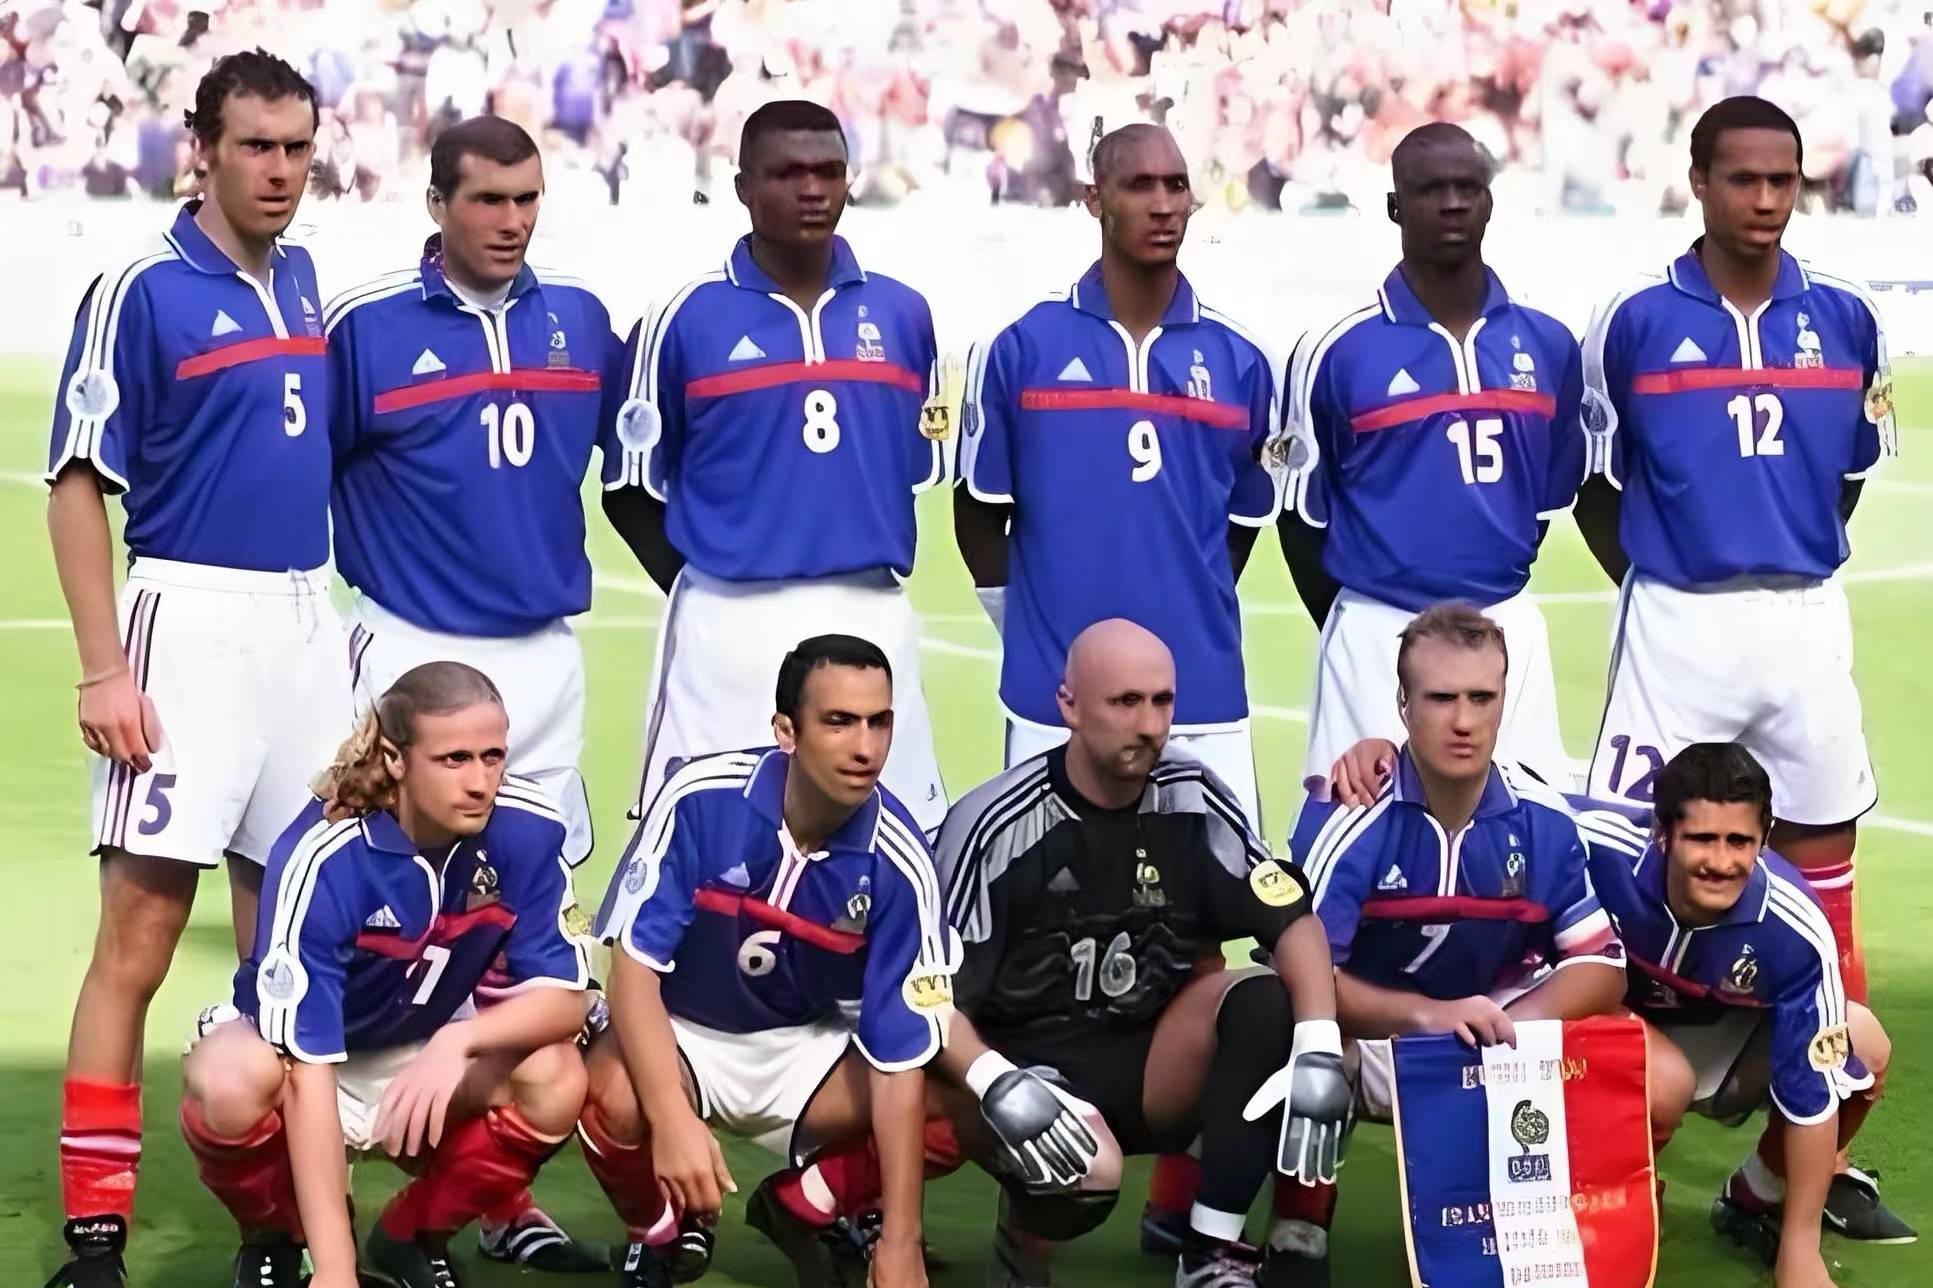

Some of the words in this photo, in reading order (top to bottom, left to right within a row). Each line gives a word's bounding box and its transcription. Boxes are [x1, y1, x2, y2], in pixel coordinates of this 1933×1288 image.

[284, 373, 307, 437] 5
[480, 402, 535, 469] 10
[803, 390, 840, 454] 8
[1727, 394, 1785, 458] 12
[1127, 420, 1164, 483] 9
[1446, 419, 1504, 484] 15
[1608, 734, 1666, 804] 12
[138, 773, 177, 836] 5
[737, 930, 782, 977] 6
[1070, 931, 1137, 1001] 16
[1404, 923, 1453, 974] 7
